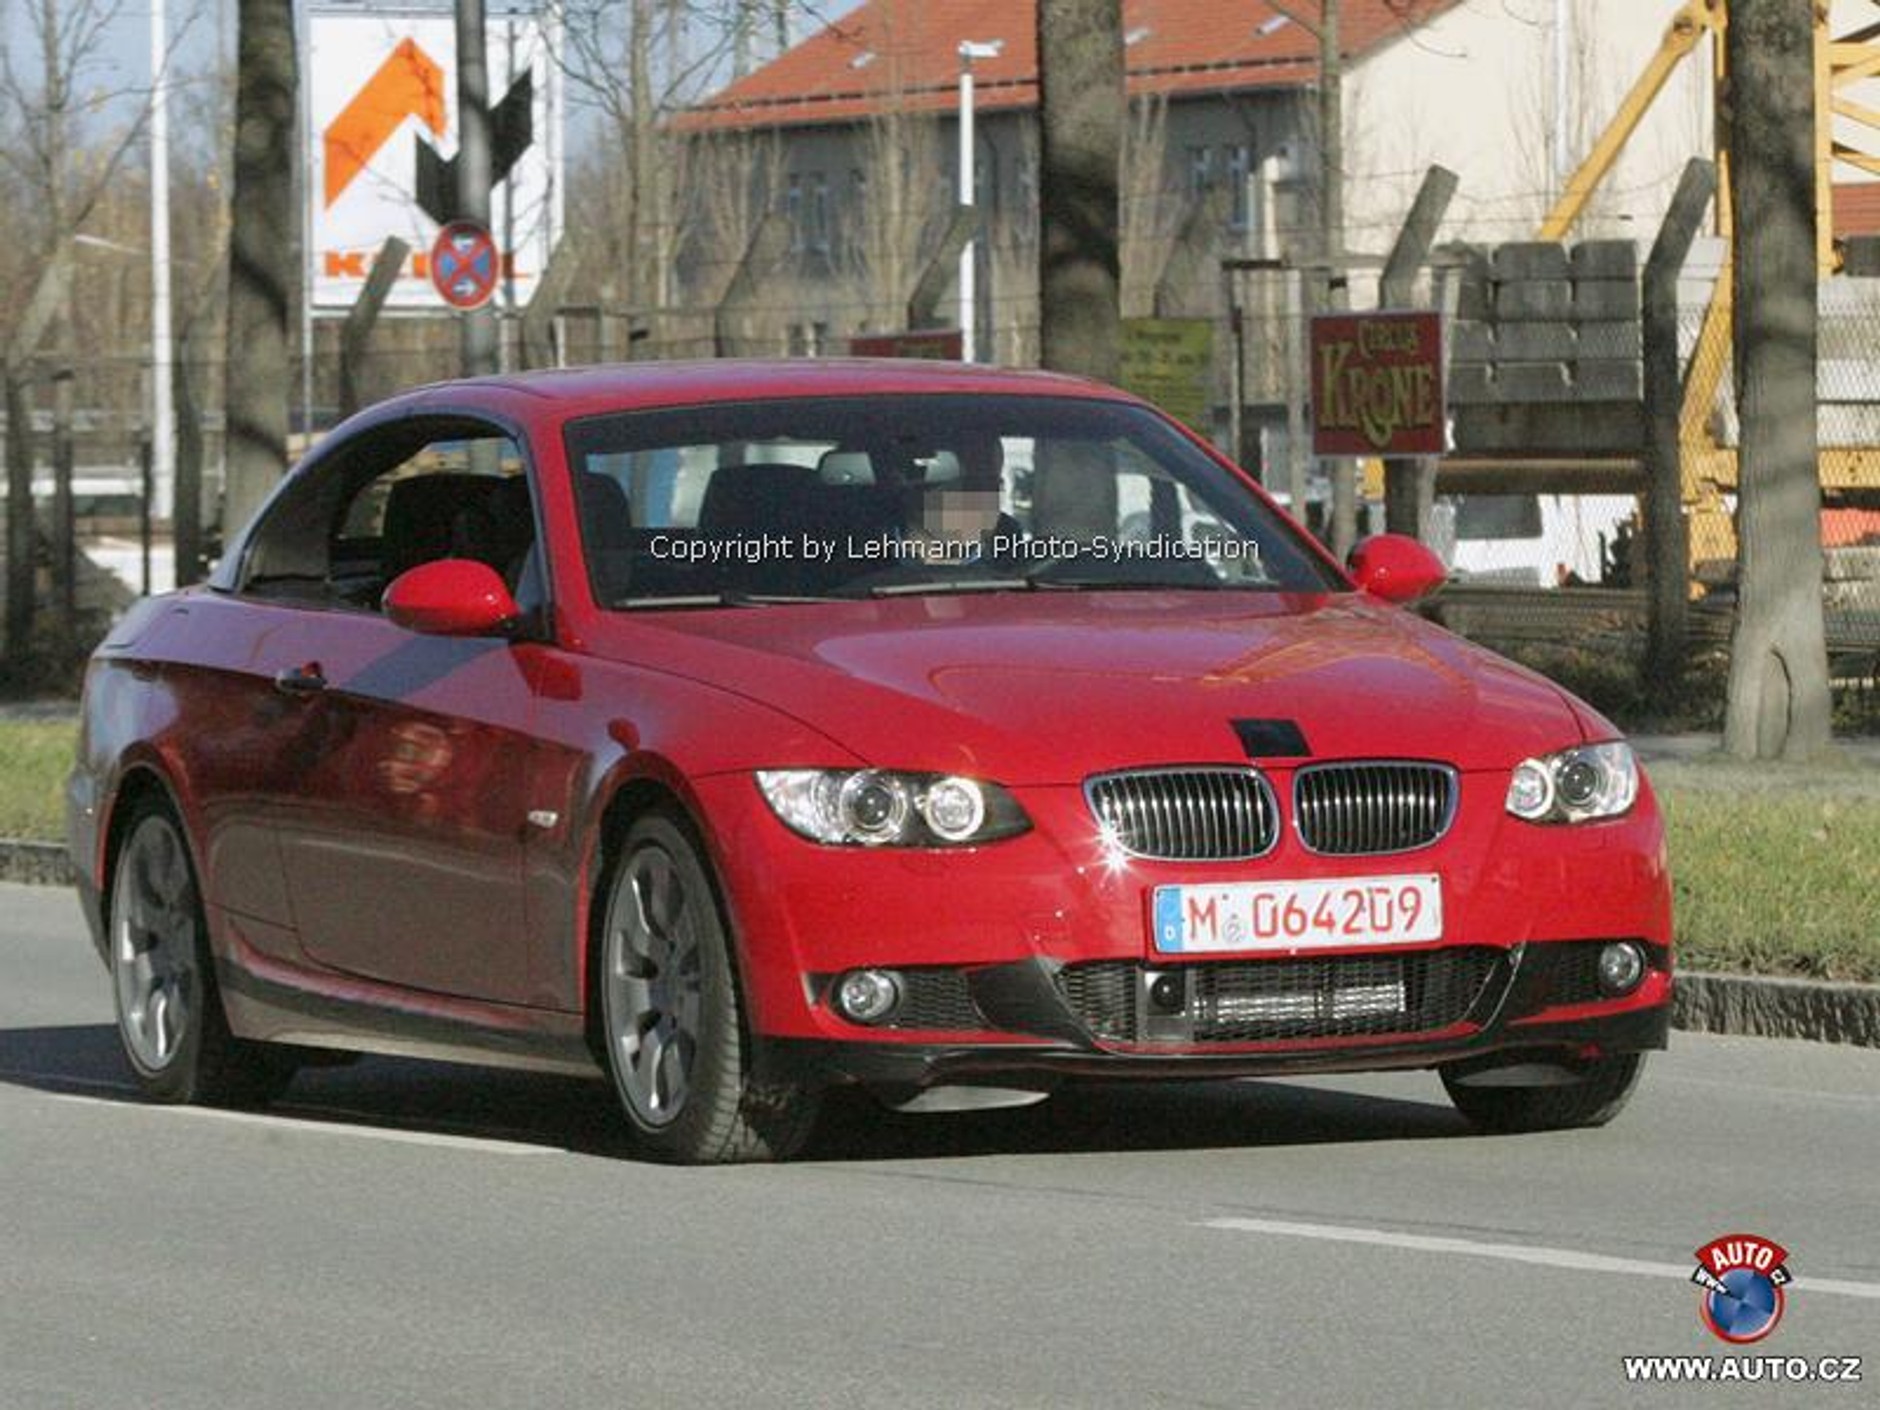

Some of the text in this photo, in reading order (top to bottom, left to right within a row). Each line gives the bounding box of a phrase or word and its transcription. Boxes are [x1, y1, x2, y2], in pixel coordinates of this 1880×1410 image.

[1319, 341, 1433, 446] KRONE
[1188, 896, 1218, 941] M
[1252, 886, 1423, 938] 064209
